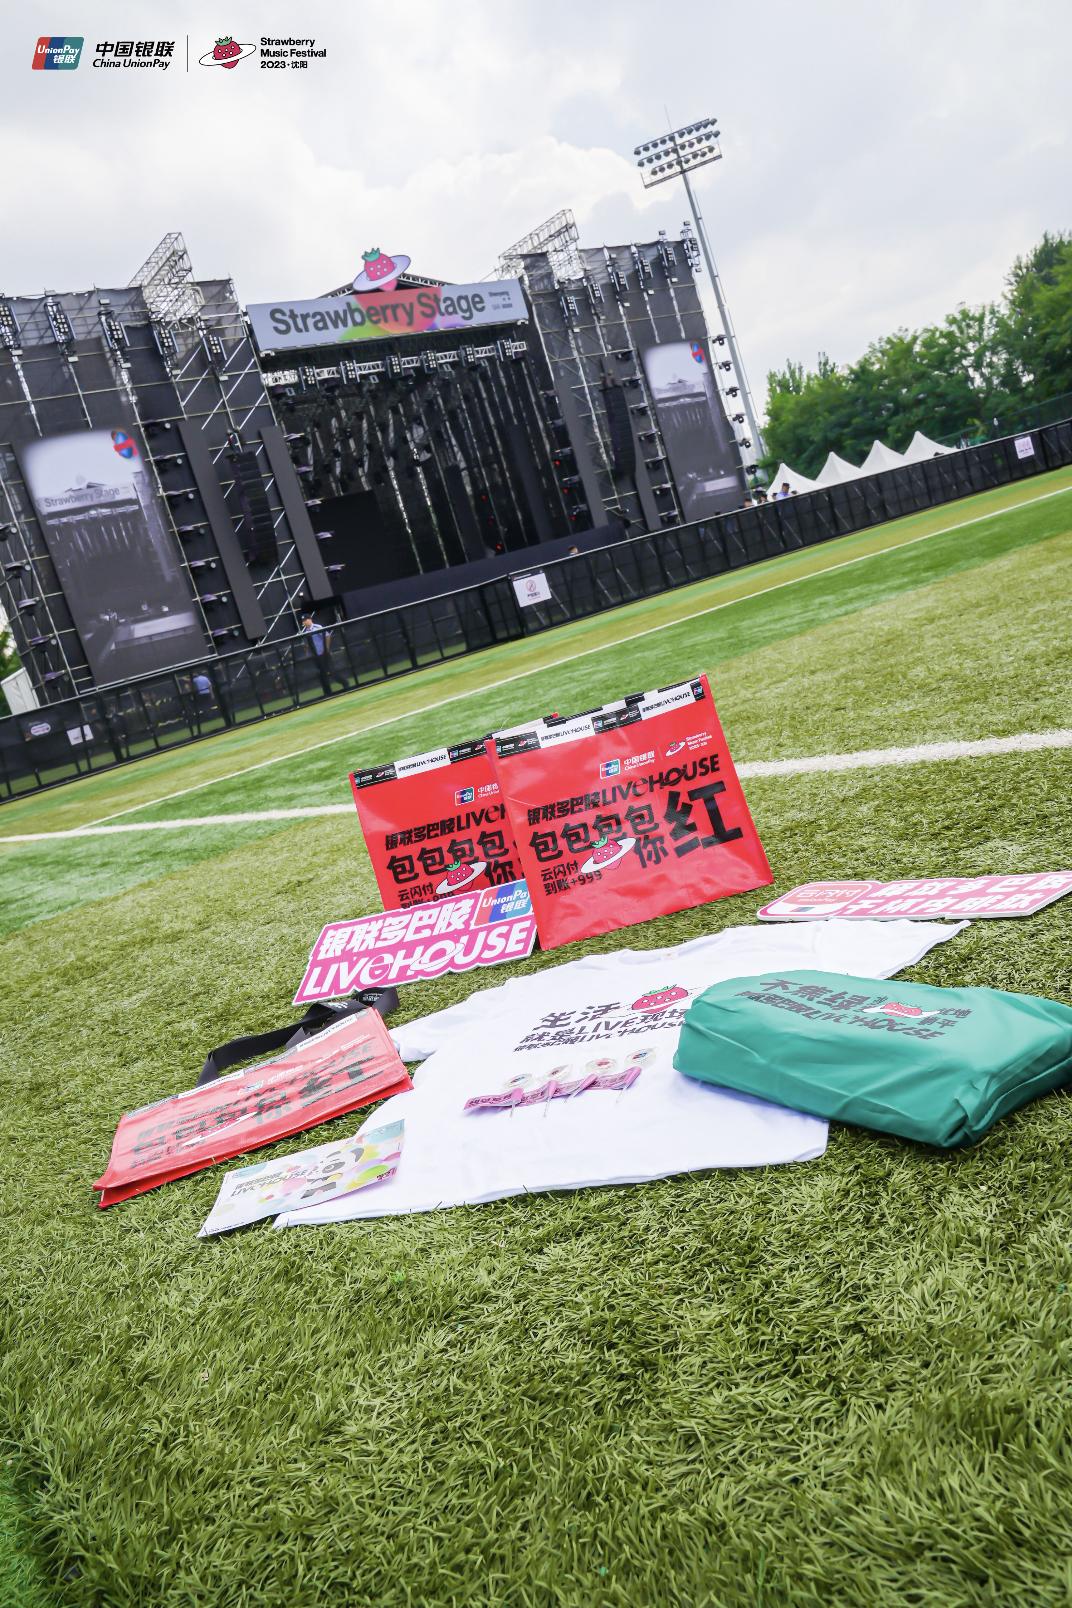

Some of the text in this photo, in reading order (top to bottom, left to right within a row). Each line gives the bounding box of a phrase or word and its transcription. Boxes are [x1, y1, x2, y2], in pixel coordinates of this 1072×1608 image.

[269, 292, 486, 335] Strawberry Stage
[44, 487, 120, 508] Strawberry Stage
[663, 780, 744, 858] 红
[633, 833, 669, 868] 你
[541, 860, 579, 880] 云闪付
[398, 882, 434, 901] 云闪付
[543, 871, 603, 896] 到账+999
[500, 899, 528, 914] 银联
